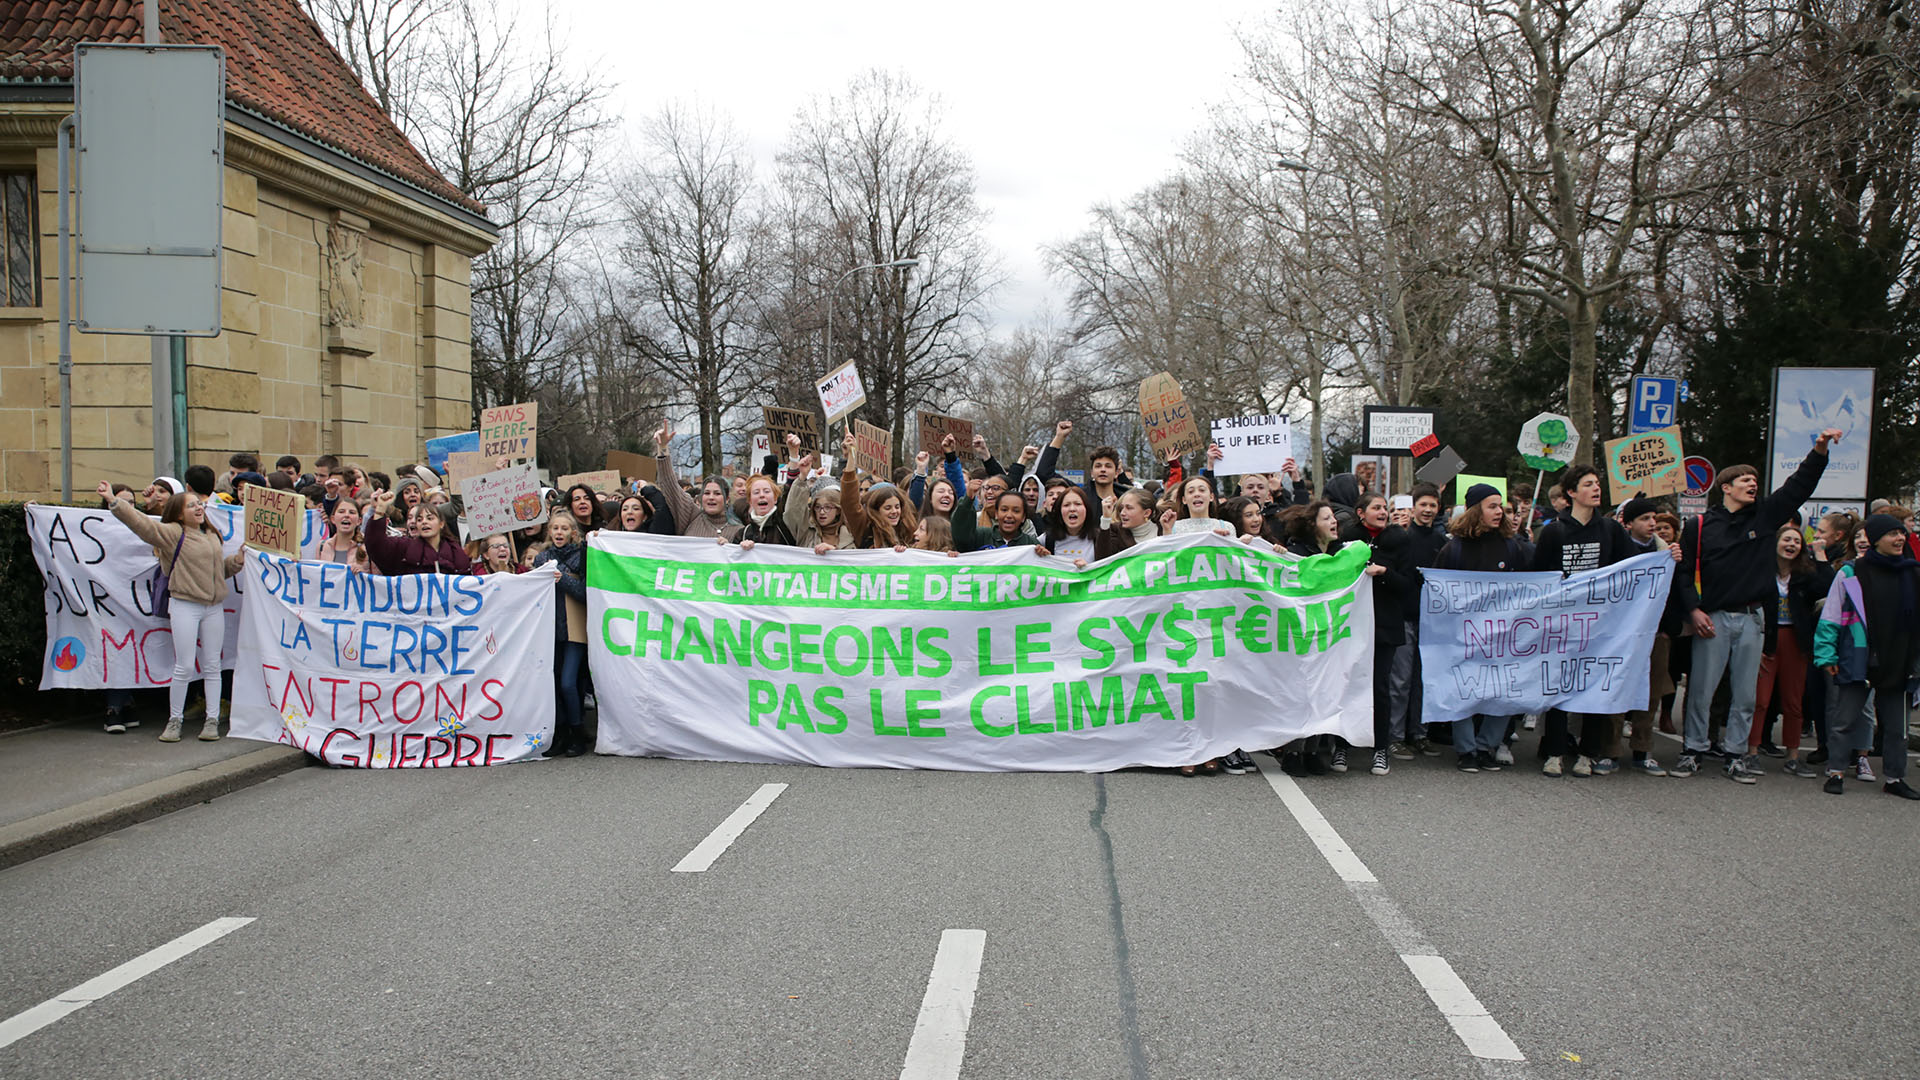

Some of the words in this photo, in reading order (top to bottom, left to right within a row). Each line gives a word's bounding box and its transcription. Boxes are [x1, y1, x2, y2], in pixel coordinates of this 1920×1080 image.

[1640, 381, 1661, 412] P
[1681, 386, 1688, 396] 2
[486, 407, 526, 423] SANS
[766, 409, 813, 432] UNFUCK
[923, 415, 944, 428] ACT
[948, 420, 973, 434] NOW
[1145, 412, 1159, 428] AU
[1164, 406, 1186, 423] LAC
[1211, 419, 1222, 430] I
[767, 428, 787, 445] THE
[1150, 427, 1166, 443] ON
[1168, 419, 1188, 437] AGIT
[1229, 436, 1242, 447] UP
[756, 438, 768, 450] WE
[858, 434, 888, 465] FUCKING
[1412, 434, 1437, 453] PANIC
[1633, 438, 1665, 453] LET'S
[1620, 450, 1664, 465] REBUILD
[1629, 463, 1648, 472] THE
[1651, 457, 1676, 467] WORLD
[1625, 468, 1656, 481] FOREST
[247, 486, 256, 502] I
[259, 488, 285, 511] HAVE
[285, 496, 296, 516] A
[253, 507, 285, 530] GREEN
[27, 511, 106, 565] AS
[248, 522, 288, 555] DREAM
[258, 552, 485, 617] DEFENDONS
[654, 566, 696, 594] LE
[707, 569, 908, 602] CAPITALISME
[923, 566, 1076, 603] DÉTRUIT
[1087, 566, 1132, 594] LA
[1144, 551, 1300, 589] PLANÈTE
[1426, 578, 1577, 615] BEHANDLE
[1587, 566, 1666, 605] LUFT
[280, 618, 312, 650] LA
[602, 607, 952, 678] CHANGEONS
[977, 621, 1055, 677] LE
[1463, 611, 1599, 660] NICHT
[321, 618, 479, 676] TERRE
[1452, 662, 1523, 701] WIE
[1541, 656, 1624, 697] LUFT
[262, 664, 505, 725] ENTRONS
[748, 679, 849, 735] PAS
[869, 688, 946, 738] LE
[969, 671, 1208, 738] CLIMAT
